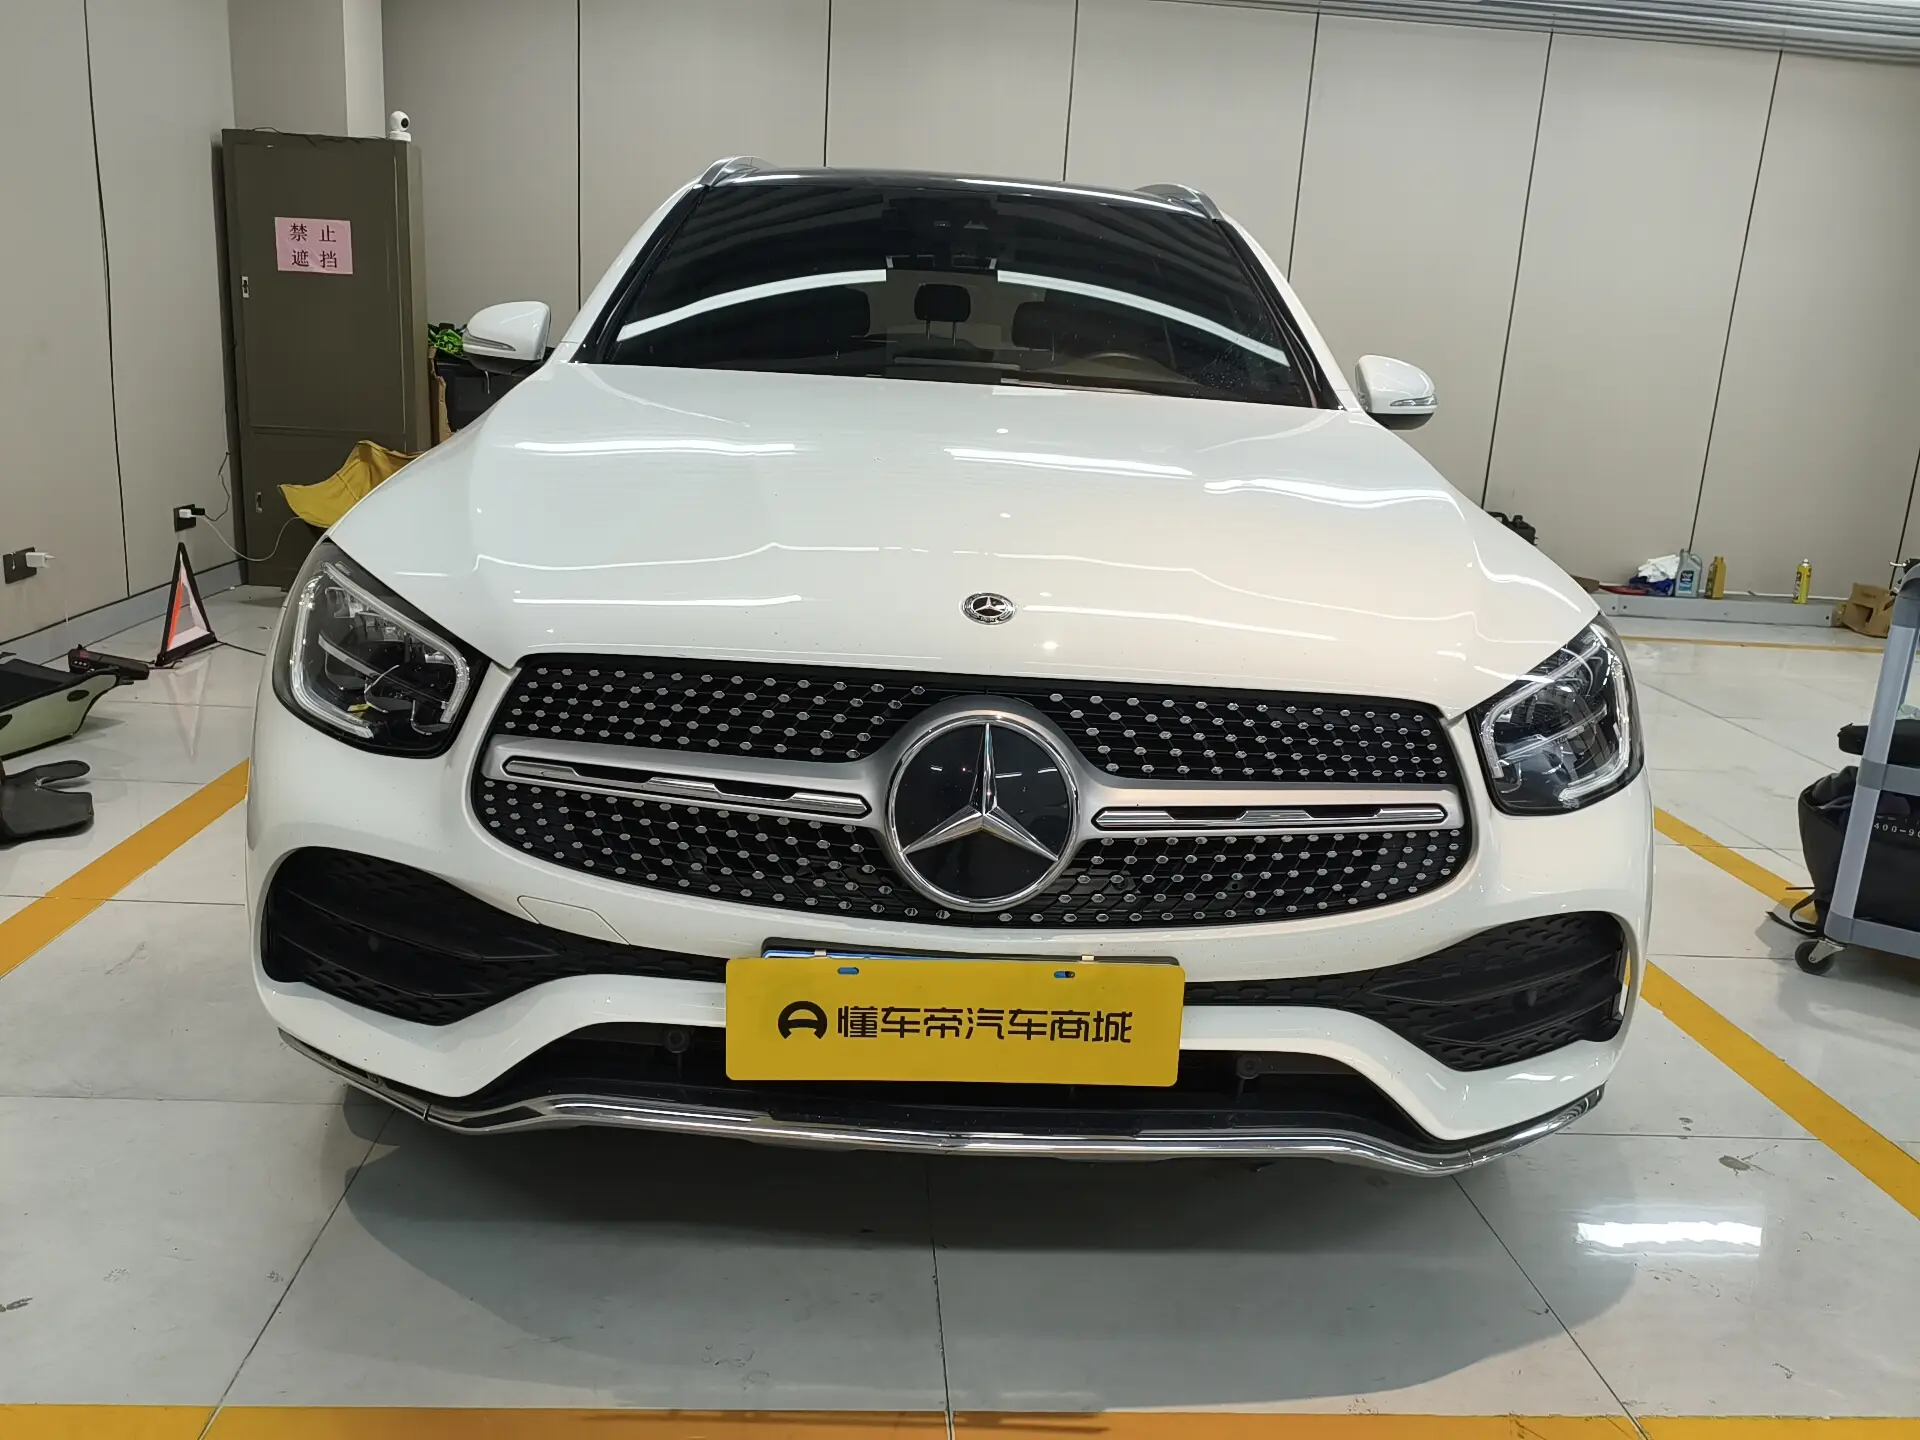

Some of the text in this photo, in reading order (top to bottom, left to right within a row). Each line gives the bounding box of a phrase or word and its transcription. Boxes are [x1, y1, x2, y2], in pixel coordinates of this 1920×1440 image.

[289, 222, 337, 243] 禁止
[291, 249, 338, 269] 遮挡
[837, 1005, 1133, 1044] 懂车帝汽车商城
